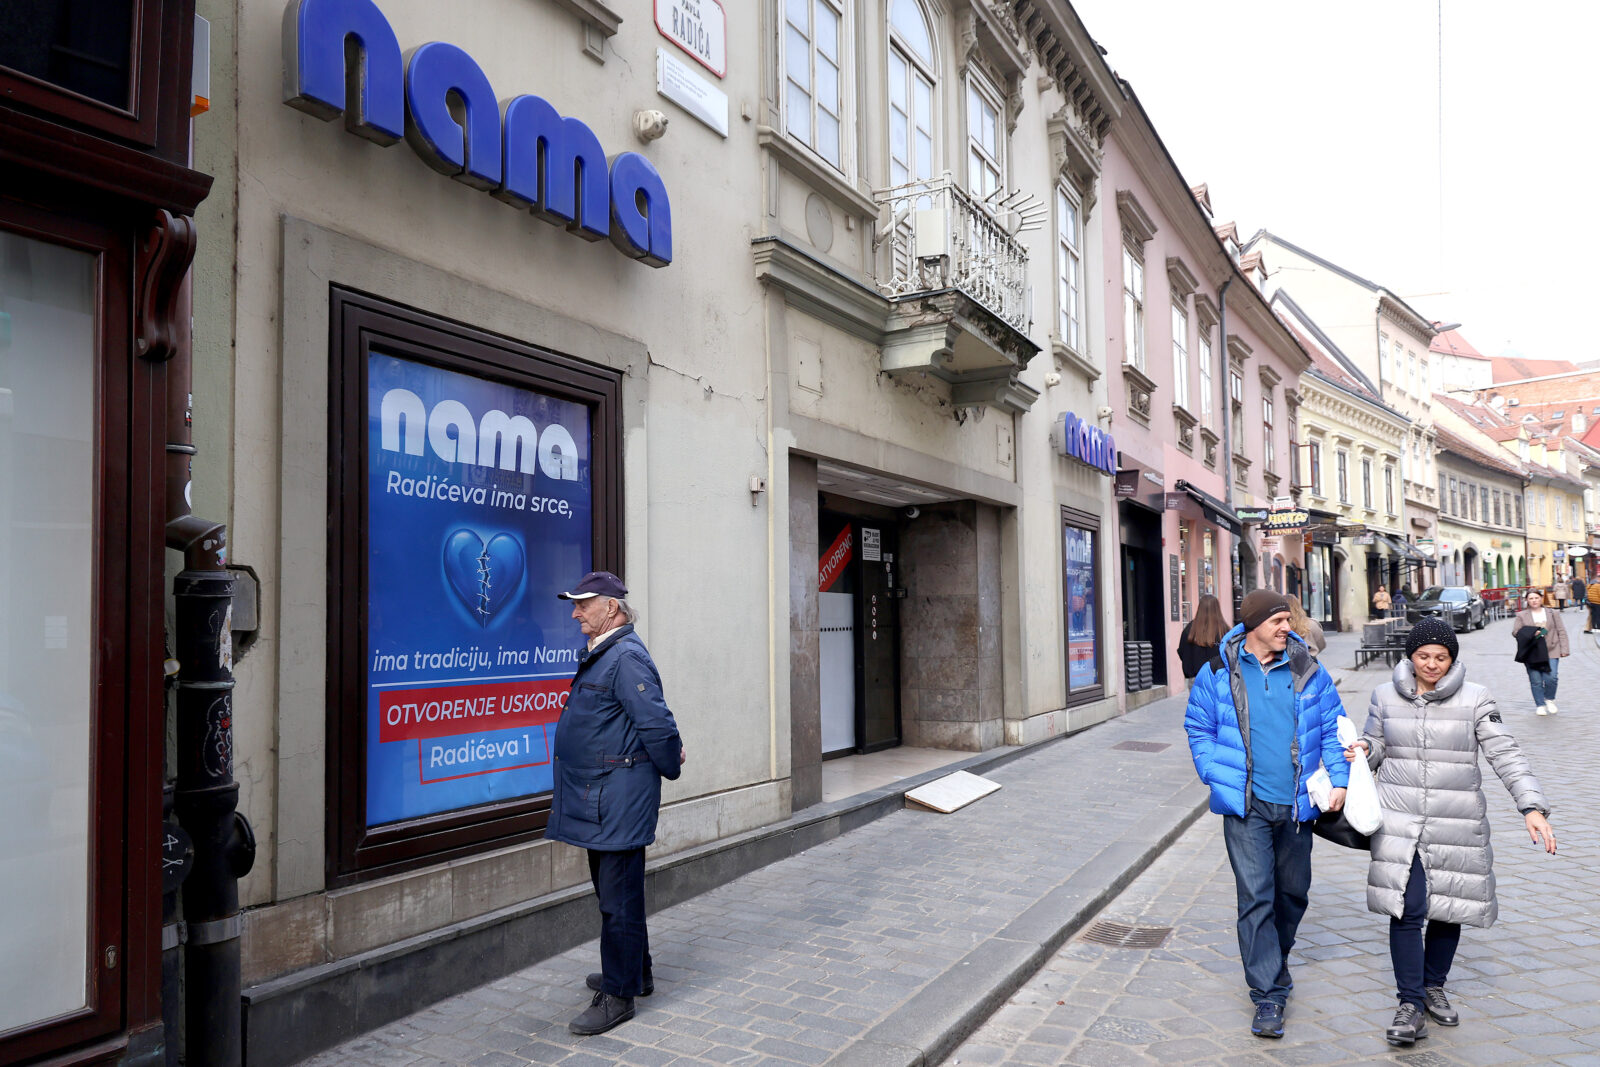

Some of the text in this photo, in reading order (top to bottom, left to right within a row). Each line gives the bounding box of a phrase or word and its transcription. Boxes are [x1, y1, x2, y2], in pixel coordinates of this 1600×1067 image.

[672, 5, 711, 60] RADIĆA
[286, 0, 673, 267] nama
[380, 388, 579, 482] nama
[386, 470, 573, 519] Radićeva ima srce,
[819, 533, 853, 588] ATVORENO
[372, 649, 408, 672] ima
[414, 646, 492, 672] tradiciju,
[496, 645, 529, 666] ima
[386, 691, 570, 726] OTVORENJE USKORO
[430, 734, 531, 768] Radićeva 1
